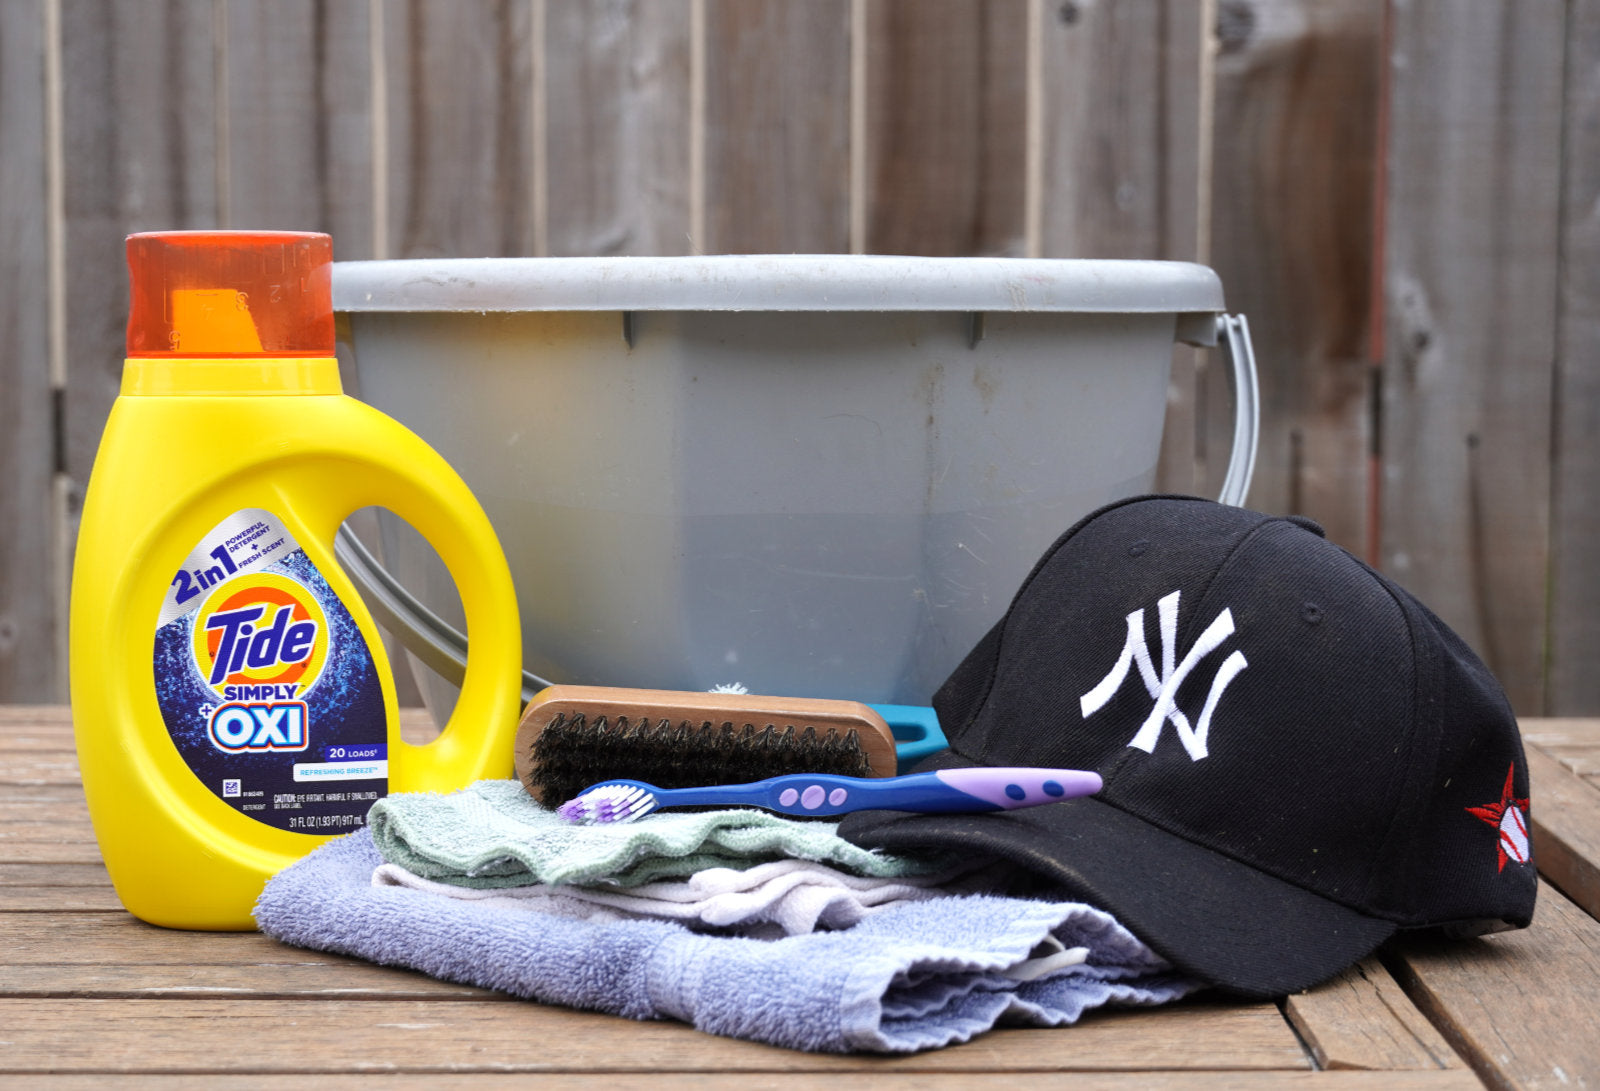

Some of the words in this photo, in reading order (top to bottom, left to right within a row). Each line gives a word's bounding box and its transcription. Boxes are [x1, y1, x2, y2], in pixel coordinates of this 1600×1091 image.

[225, 521, 265, 547] POWERFUL
[229, 525, 270, 553] DETERGENT
[238, 552, 262, 569] FRESH
[262, 538, 285, 555] SCENT
[171, 544, 238, 605] 2in1
[205, 605, 316, 685] Tide
[1080, 590, 1248, 762] NY
[224, 685, 298, 701] SIMPLY
[212, 705, 303, 747] OXI
[329, 748, 345, 758] 20
[300, 768, 345, 776] REFRESHING
[273, 793, 297, 803] CAUTION:
[297, 794, 305, 802] EYE
[289, 817, 297, 828] 31
[298, 817, 306, 827] FL
[307, 816, 315, 827] OZ
[316, 816, 331, 828] (1.93
[342, 815, 353, 826] 917
